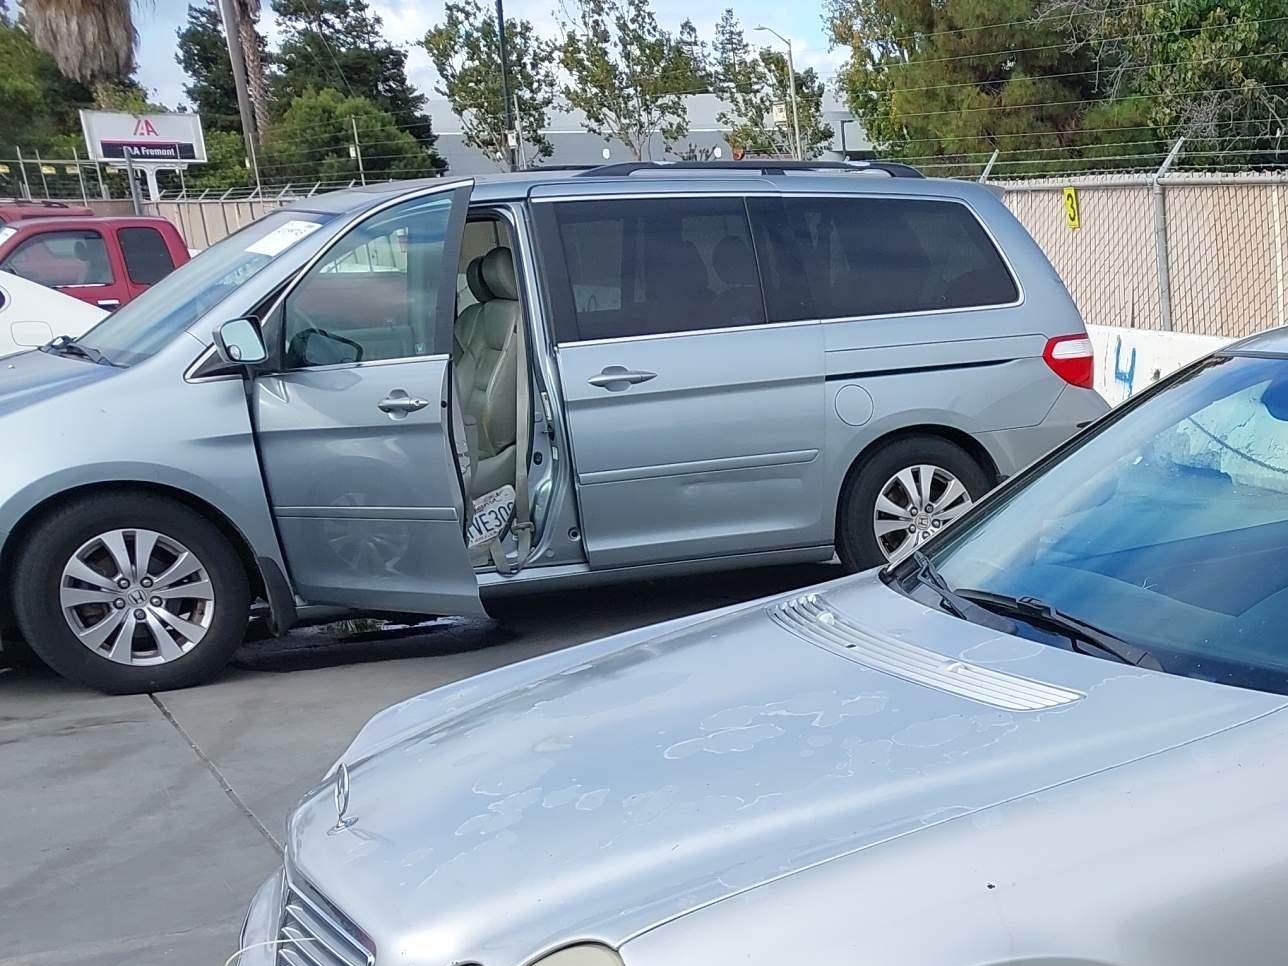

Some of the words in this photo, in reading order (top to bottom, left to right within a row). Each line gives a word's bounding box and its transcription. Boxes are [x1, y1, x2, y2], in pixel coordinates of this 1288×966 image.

[141, 146, 175, 156] Fremont
[1066, 193, 1076, 222] 3
[1115, 334, 1137, 398] 4
